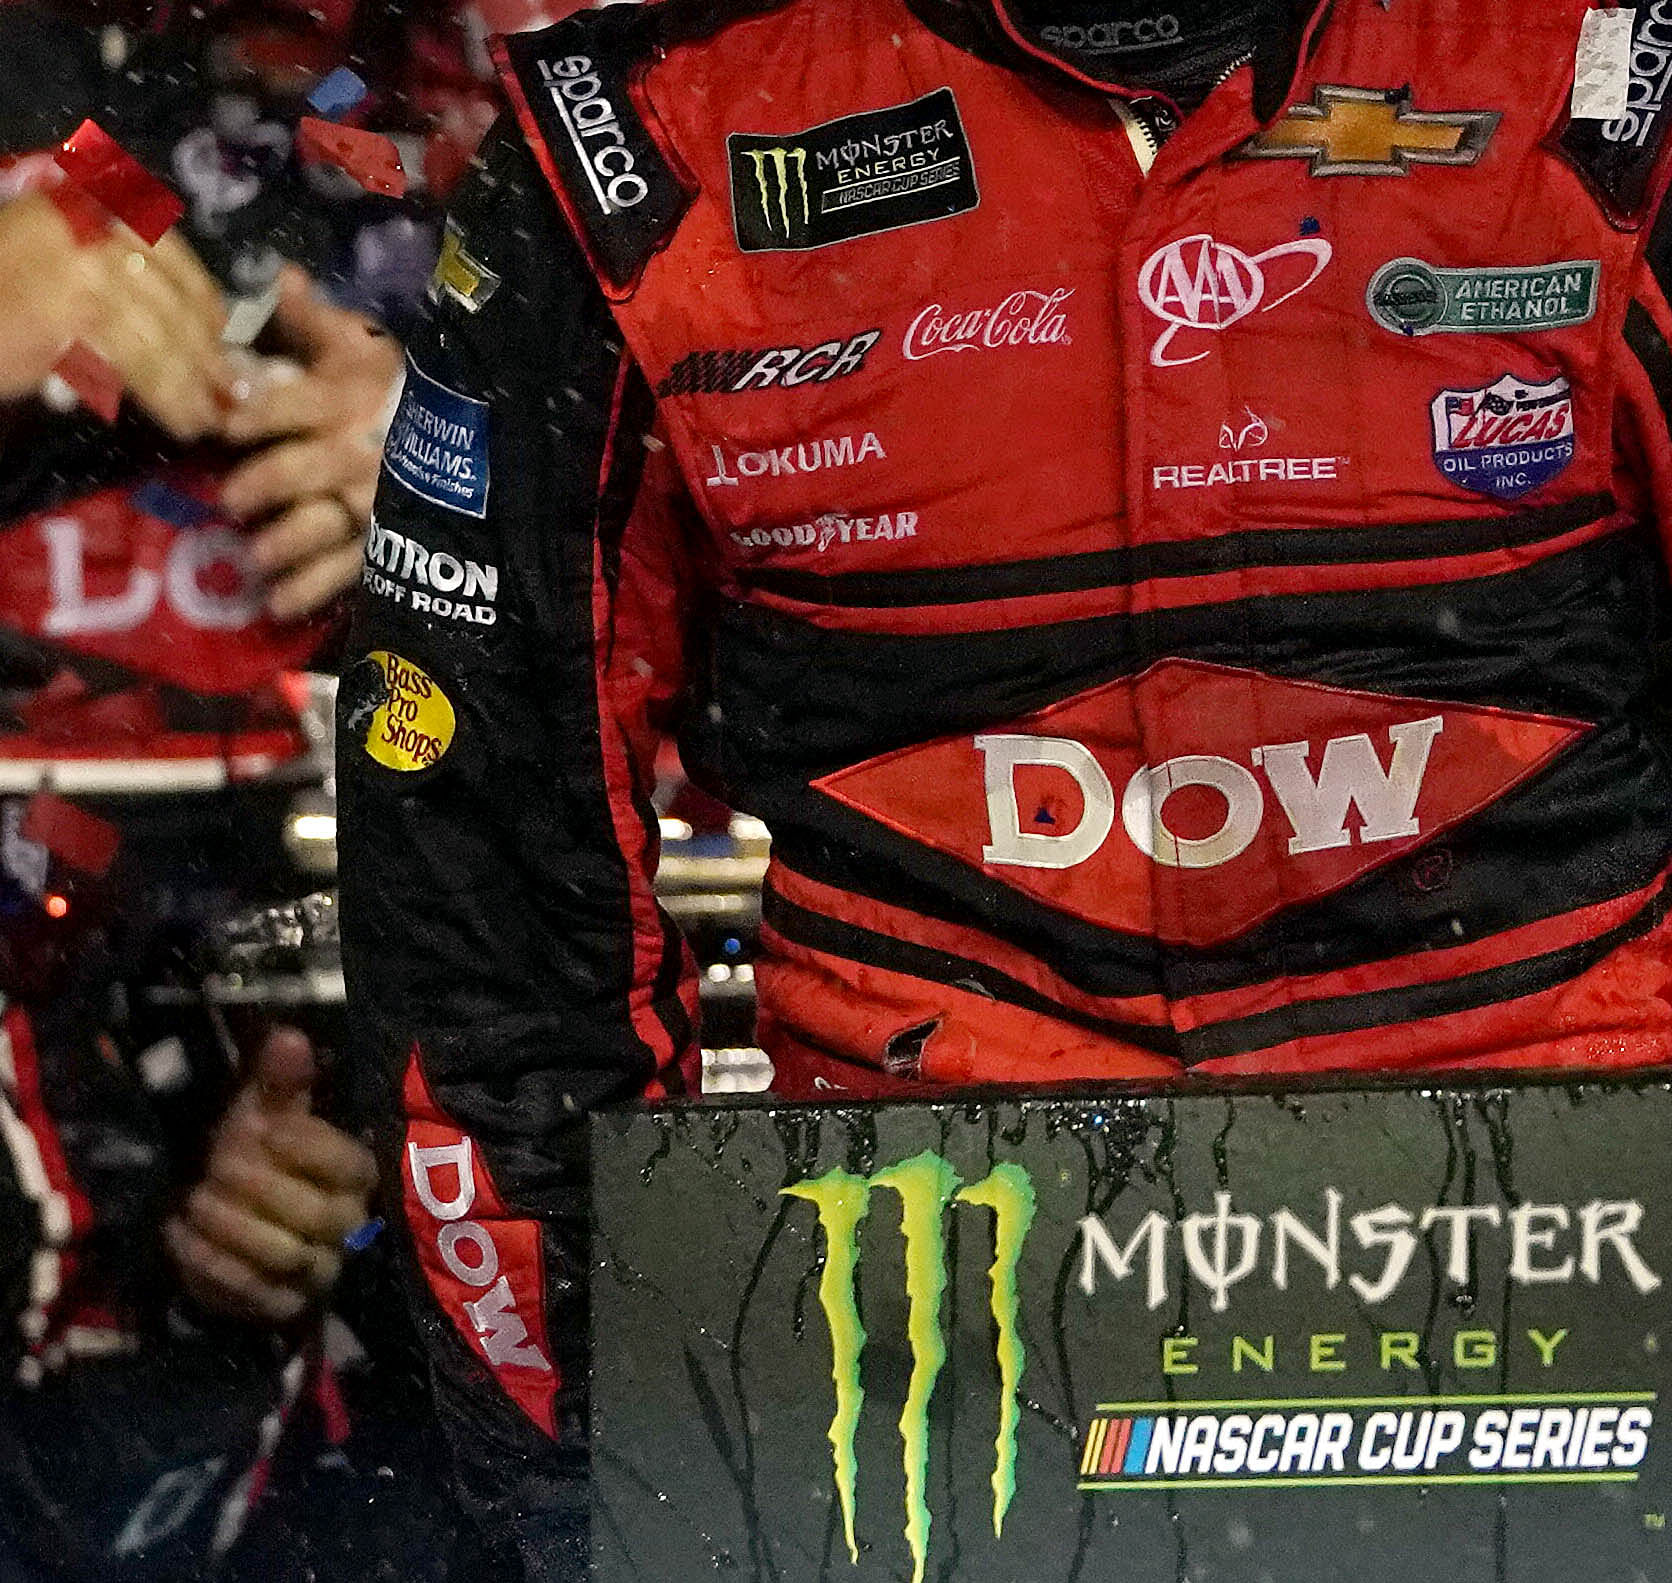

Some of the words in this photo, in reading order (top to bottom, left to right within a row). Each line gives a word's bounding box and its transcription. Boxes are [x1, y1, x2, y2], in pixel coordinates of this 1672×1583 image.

[1040, 15, 1179, 49] sparco
[541, 55, 649, 209] sparco
[816, 119, 954, 171] MONSTER
[838, 148, 940, 184] ENERGY
[1156, 244, 1253, 323] AAA
[1455, 272, 1582, 300] AMERICAN
[902, 287, 1076, 360] Coca-Cola
[1461, 297, 1572, 321] ETHANOL
[731, 330, 881, 391] RCR
[1452, 404, 1570, 449] LUCAS
[1153, 456, 1337, 490] REALTREE
[1443, 458, 1476, 472] OIL
[1481, 443, 1573, 469] PRODUCTS
[1495, 473, 1532, 488] INC.
[411, 590, 497, 626] ROAD
[386, 653, 433, 700] Bass
[387, 687, 419, 722] Pro
[381, 716, 443, 764] Shops
[973, 714, 1444, 870] DOW
[407, 1134, 553, 1372] DOW
[1076, 1186, 1662, 1312] MONSTER
[1162, 1327, 1569, 1376] ENERGY
[1143, 1412, 1353, 1476] NASCAR
[1357, 1410, 1467, 1472] CUP
[1467, 1406, 1655, 1472] SERIES
